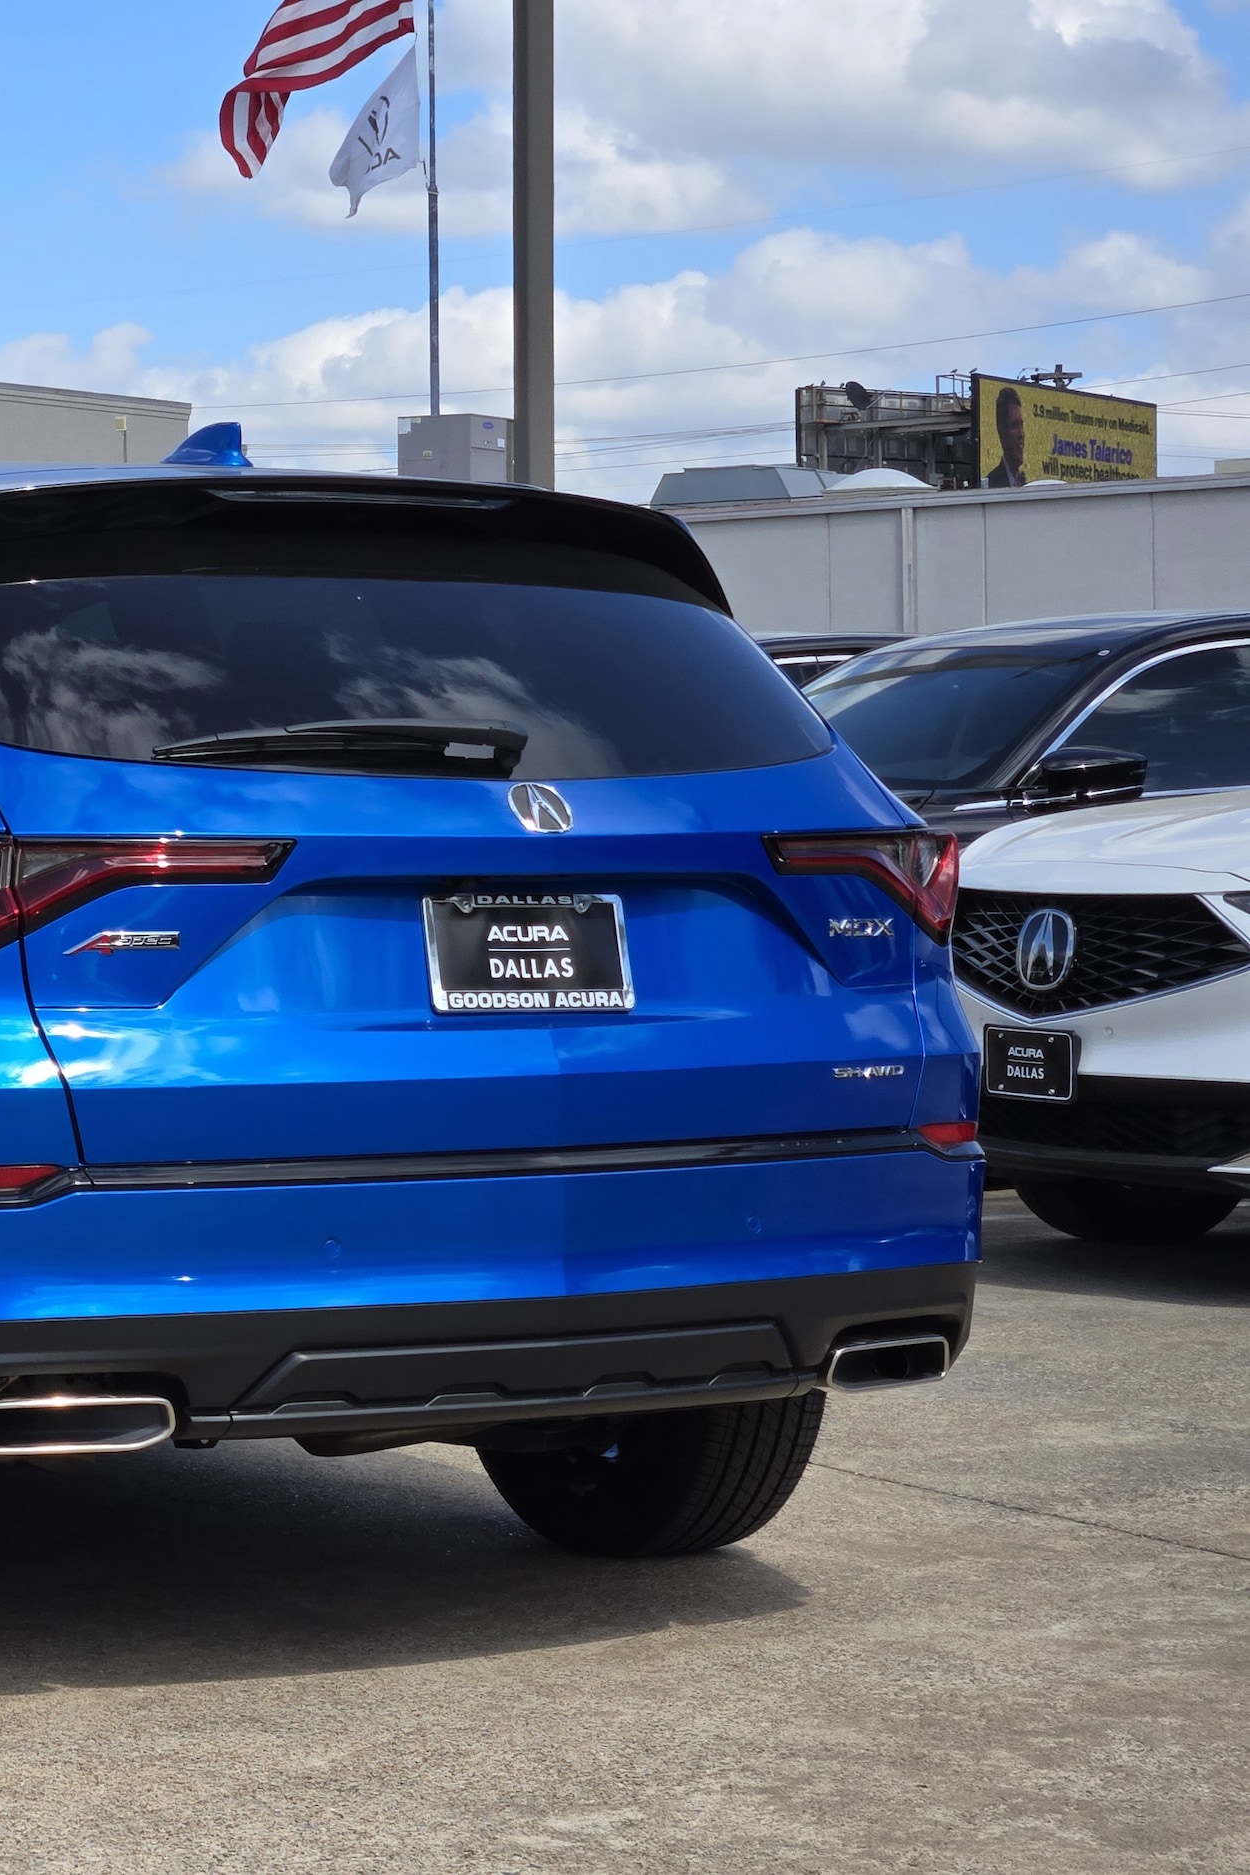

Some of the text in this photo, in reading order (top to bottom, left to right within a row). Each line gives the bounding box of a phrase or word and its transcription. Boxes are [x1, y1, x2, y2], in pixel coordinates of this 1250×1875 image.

[1032, 404, 1045, 419] 3.9
[1045, 405, 1069, 423] million
[1094, 415, 1108, 431] rely
[1109, 419, 1117, 430] on
[1051, 433, 1133, 466] James Talarico
[1042, 456, 1059, 476] will
[1060, 463, 1092, 481] protect
[477, 895, 573, 905] DALLAS
[487, 925, 569, 942] ACURA
[829, 918, 894, 937] MDX
[489, 957, 574, 979] DALLAS
[449, 991, 624, 1009] GOODSON ACURA
[1007, 1046, 1044, 1059] ACURA
[1006, 1064, 1045, 1080] DALLAS
